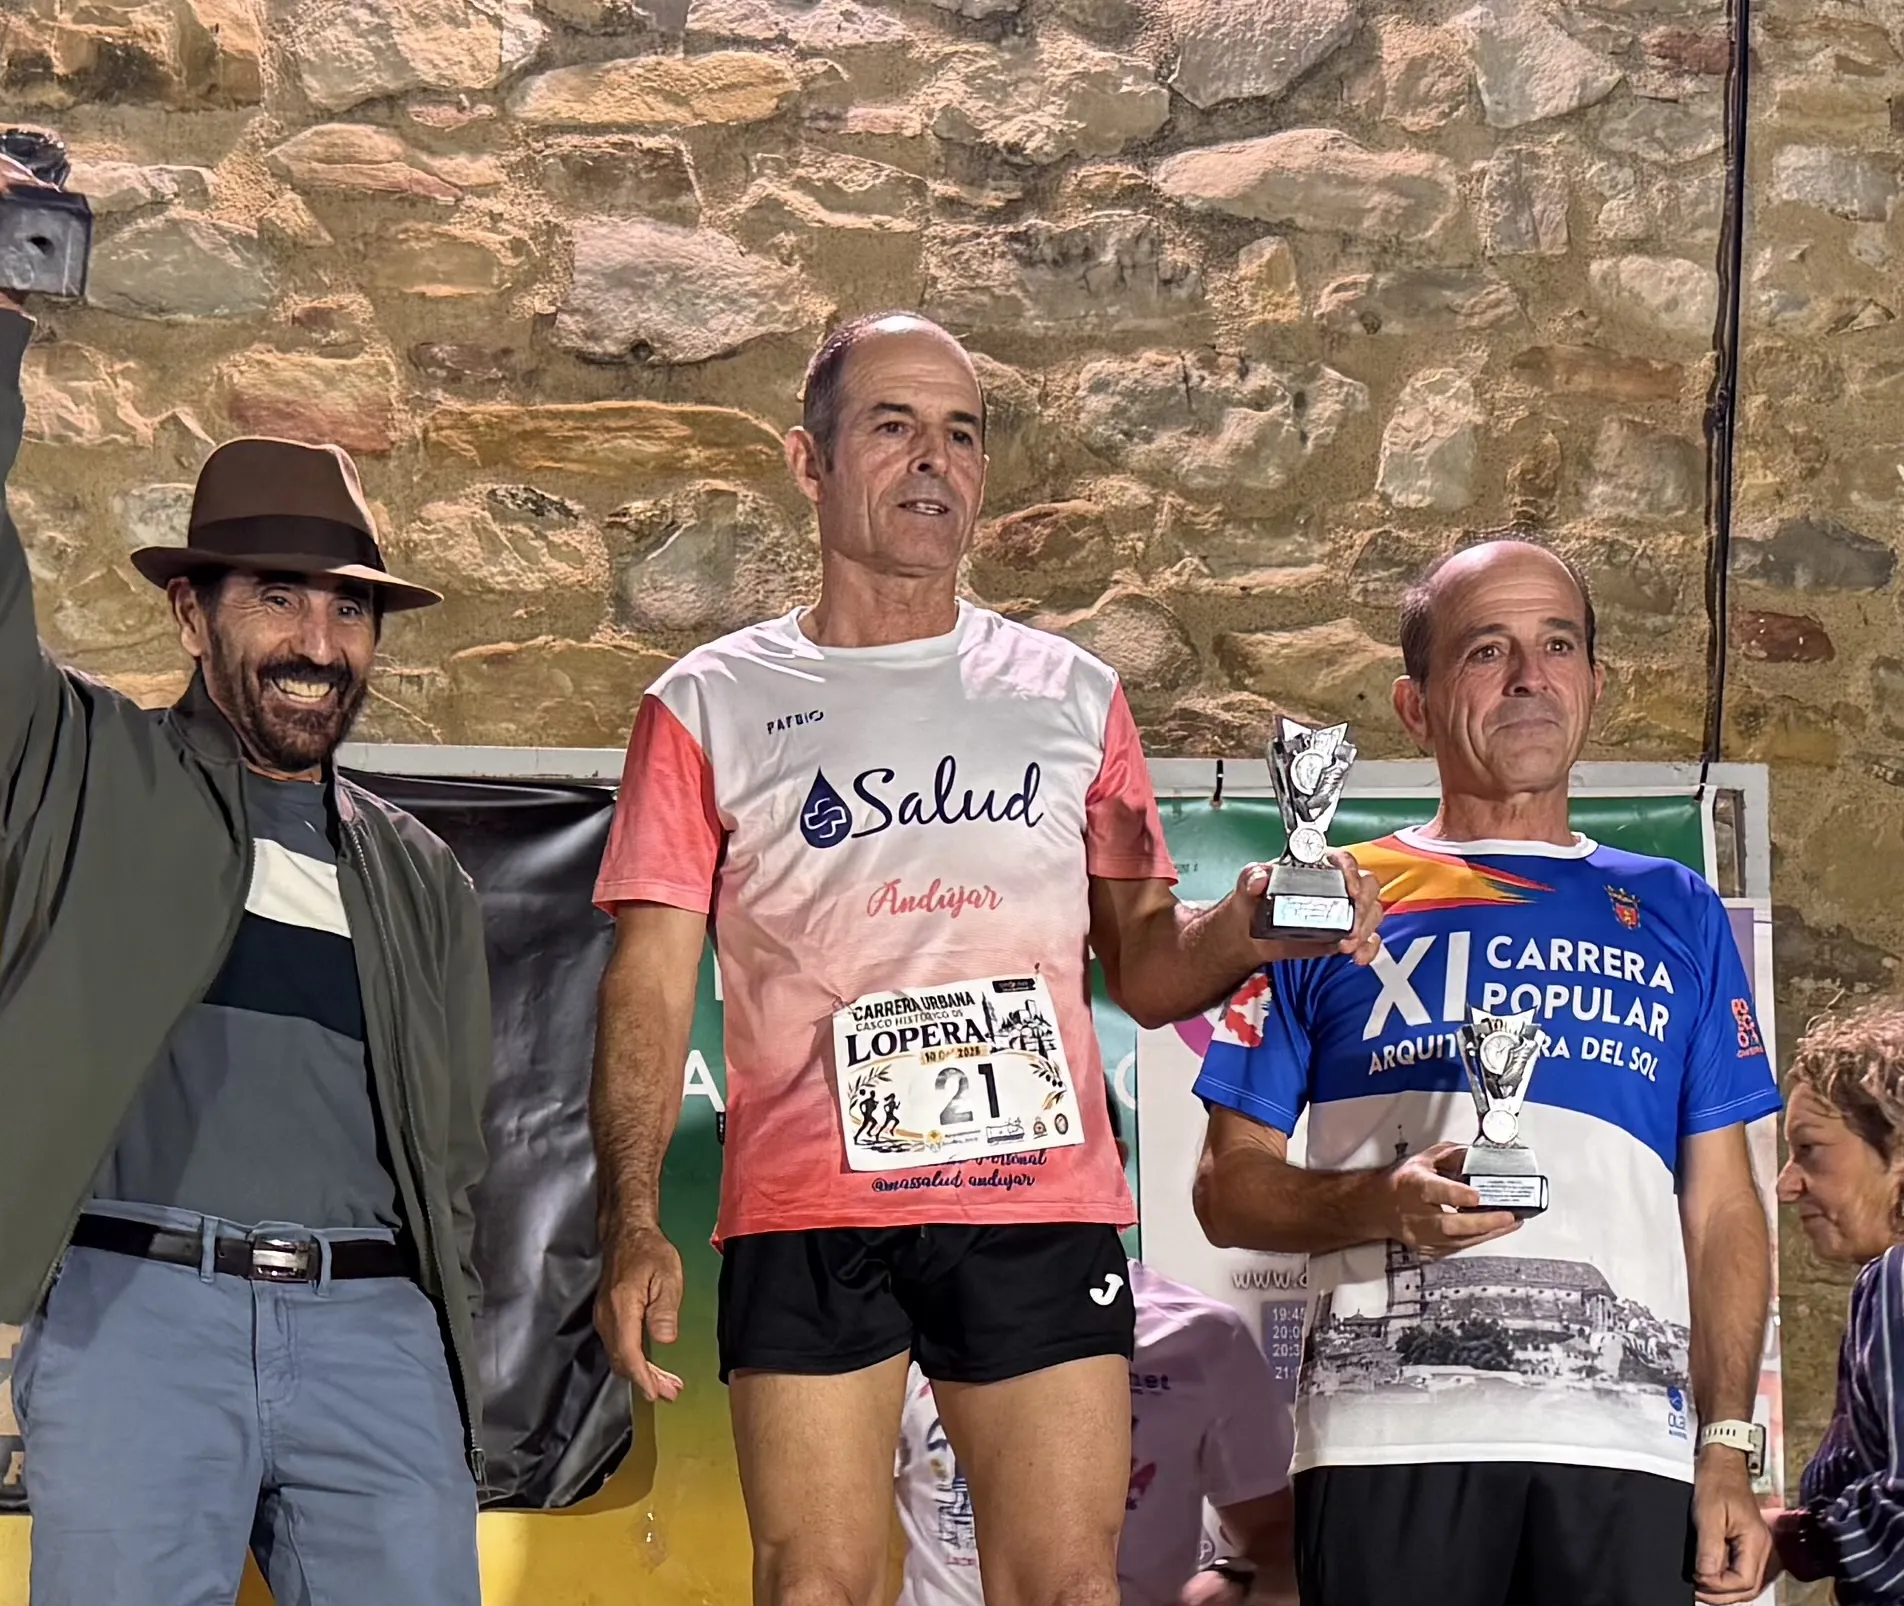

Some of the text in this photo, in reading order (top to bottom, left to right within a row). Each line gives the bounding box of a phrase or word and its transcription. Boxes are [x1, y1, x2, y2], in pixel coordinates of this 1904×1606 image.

[851, 755, 1044, 839] Salud
[1362, 930, 1471, 1042] XI
[1486, 935, 1675, 995] CARRERA
[852, 991, 976, 1022] CARRERA URBANA
[856, 1017, 892, 1032] CASCO
[1482, 982, 1671, 1043] POPULAR
[845, 1018, 988, 1067] LOPERA
[1368, 1032, 1659, 1083] ARQUITRA DEL SOL
[934, 1062, 1000, 1126] 21
[1272, 1325, 1301, 1340] 20:0
